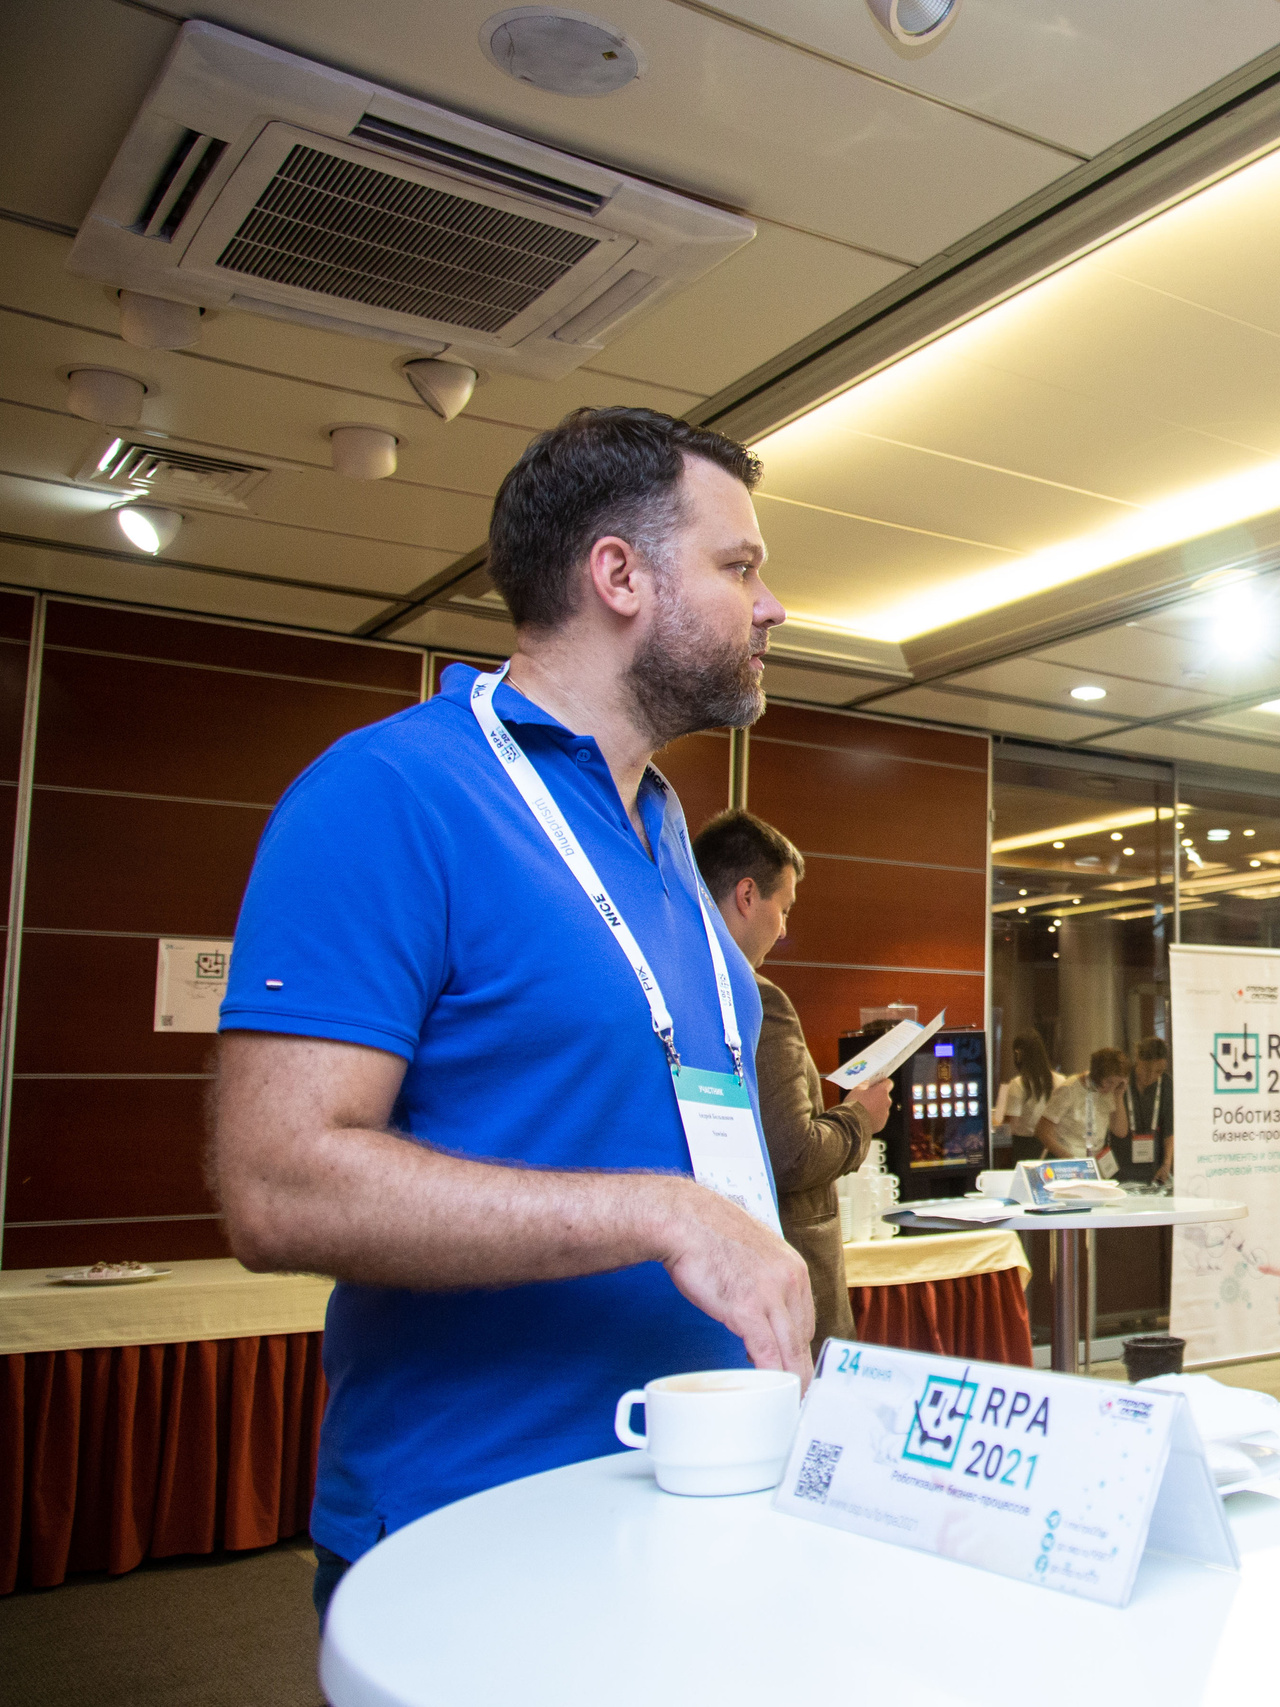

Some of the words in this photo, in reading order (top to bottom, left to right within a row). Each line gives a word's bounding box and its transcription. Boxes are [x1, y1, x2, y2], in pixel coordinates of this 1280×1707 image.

[490, 730, 506, 750] RPA
[531, 797, 575, 857] blueprism
[591, 893, 621, 927] NICE
[635, 965, 653, 991] PIX
[837, 1348, 861, 1376] 24
[981, 1386, 1050, 1437] RPA
[964, 1440, 1039, 1491] 2021
[891, 1470, 945, 1493] Роботизация
[947, 1484, 1031, 1516] бизнес-процессов
